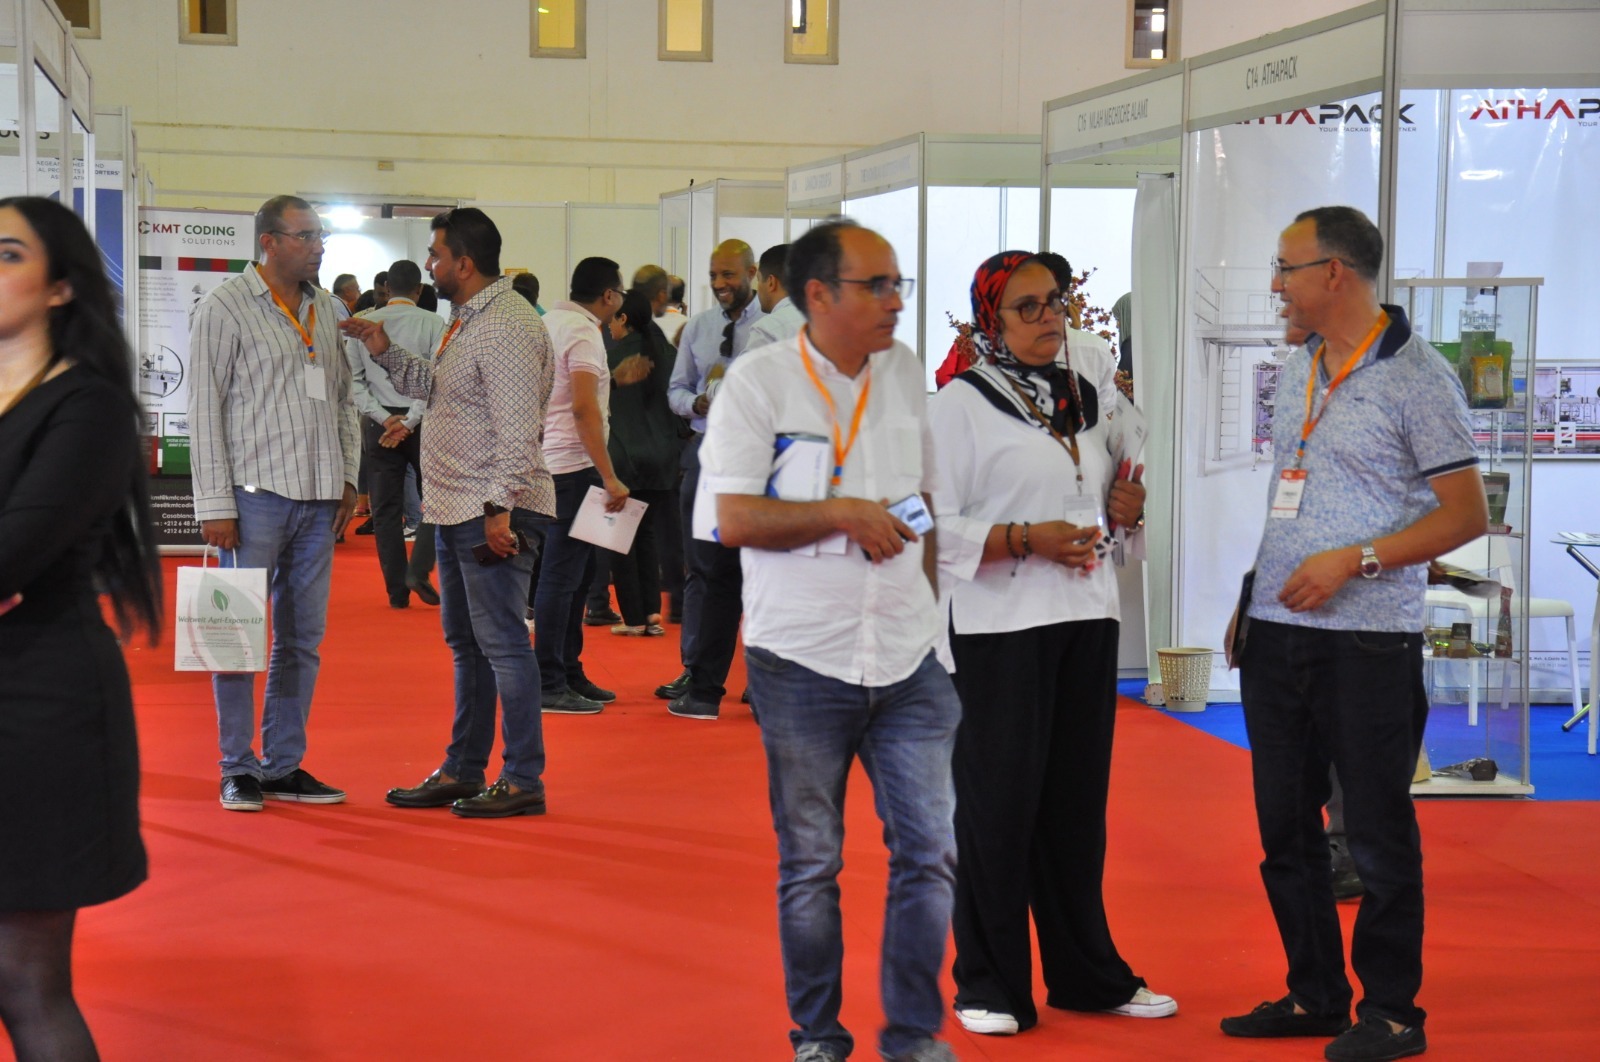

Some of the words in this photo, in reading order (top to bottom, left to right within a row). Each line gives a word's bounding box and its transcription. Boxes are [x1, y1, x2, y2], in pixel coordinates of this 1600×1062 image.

[1246, 66, 1258, 90] C14
[1261, 55, 1298, 86] ATHAPACK
[1469, 98, 1600, 120] ATHAP
[152, 223, 181, 234] KMT
[184, 224, 236, 237] CODING
[182, 237, 236, 246] SOLUTIONS
